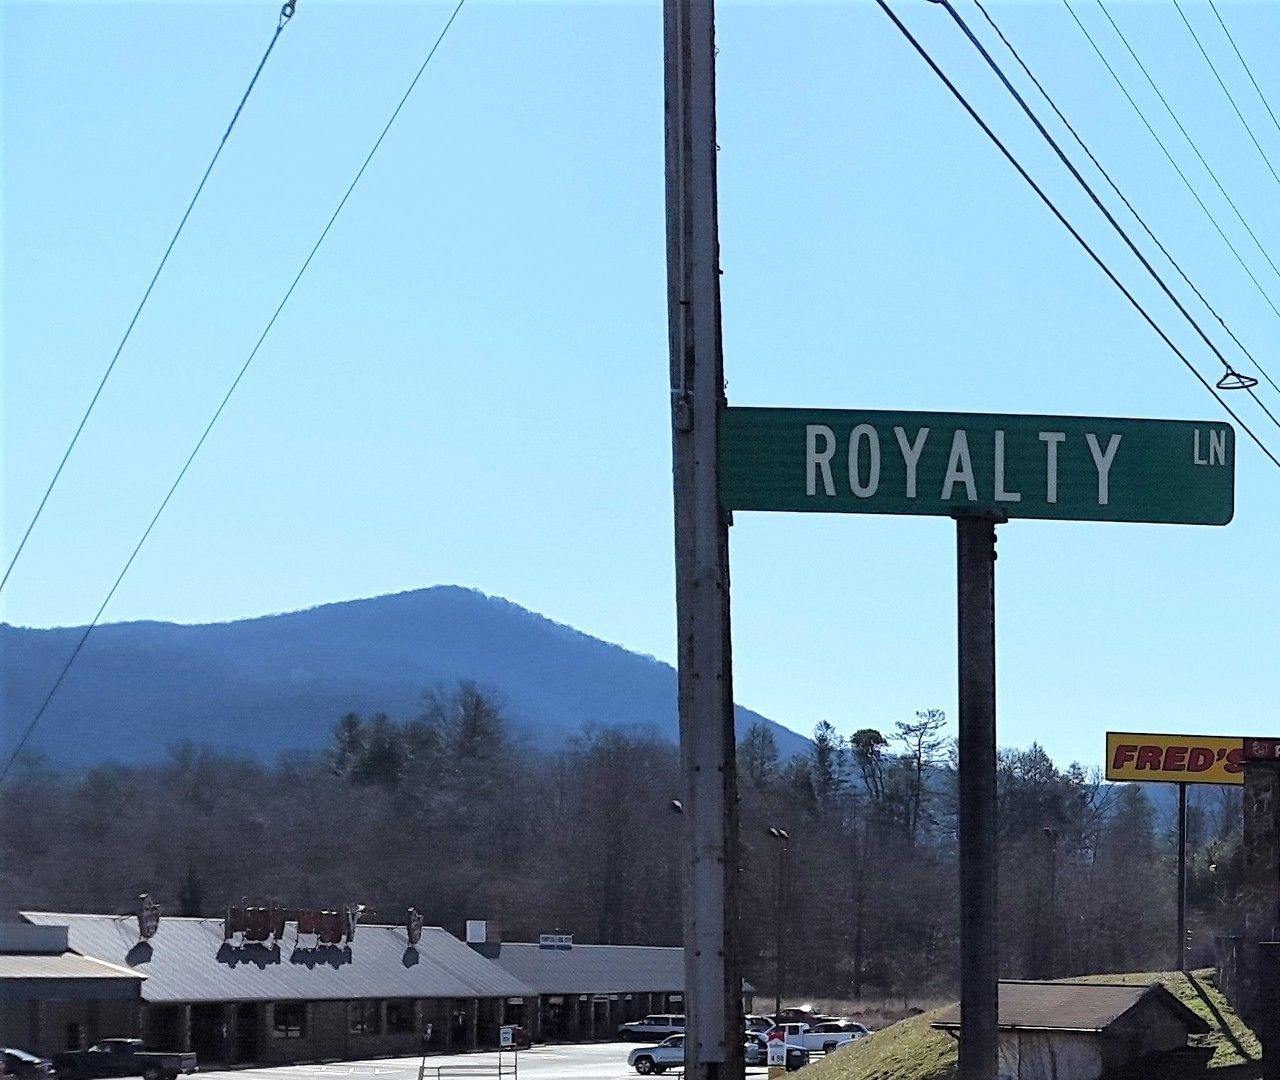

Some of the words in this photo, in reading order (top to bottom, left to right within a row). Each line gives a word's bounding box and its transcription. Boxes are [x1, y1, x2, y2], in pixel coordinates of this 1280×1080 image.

[806, 423, 1122, 505] ROYALTY
[1193, 428, 1226, 467] LN
[1112, 743, 1244, 774] FRED'S
